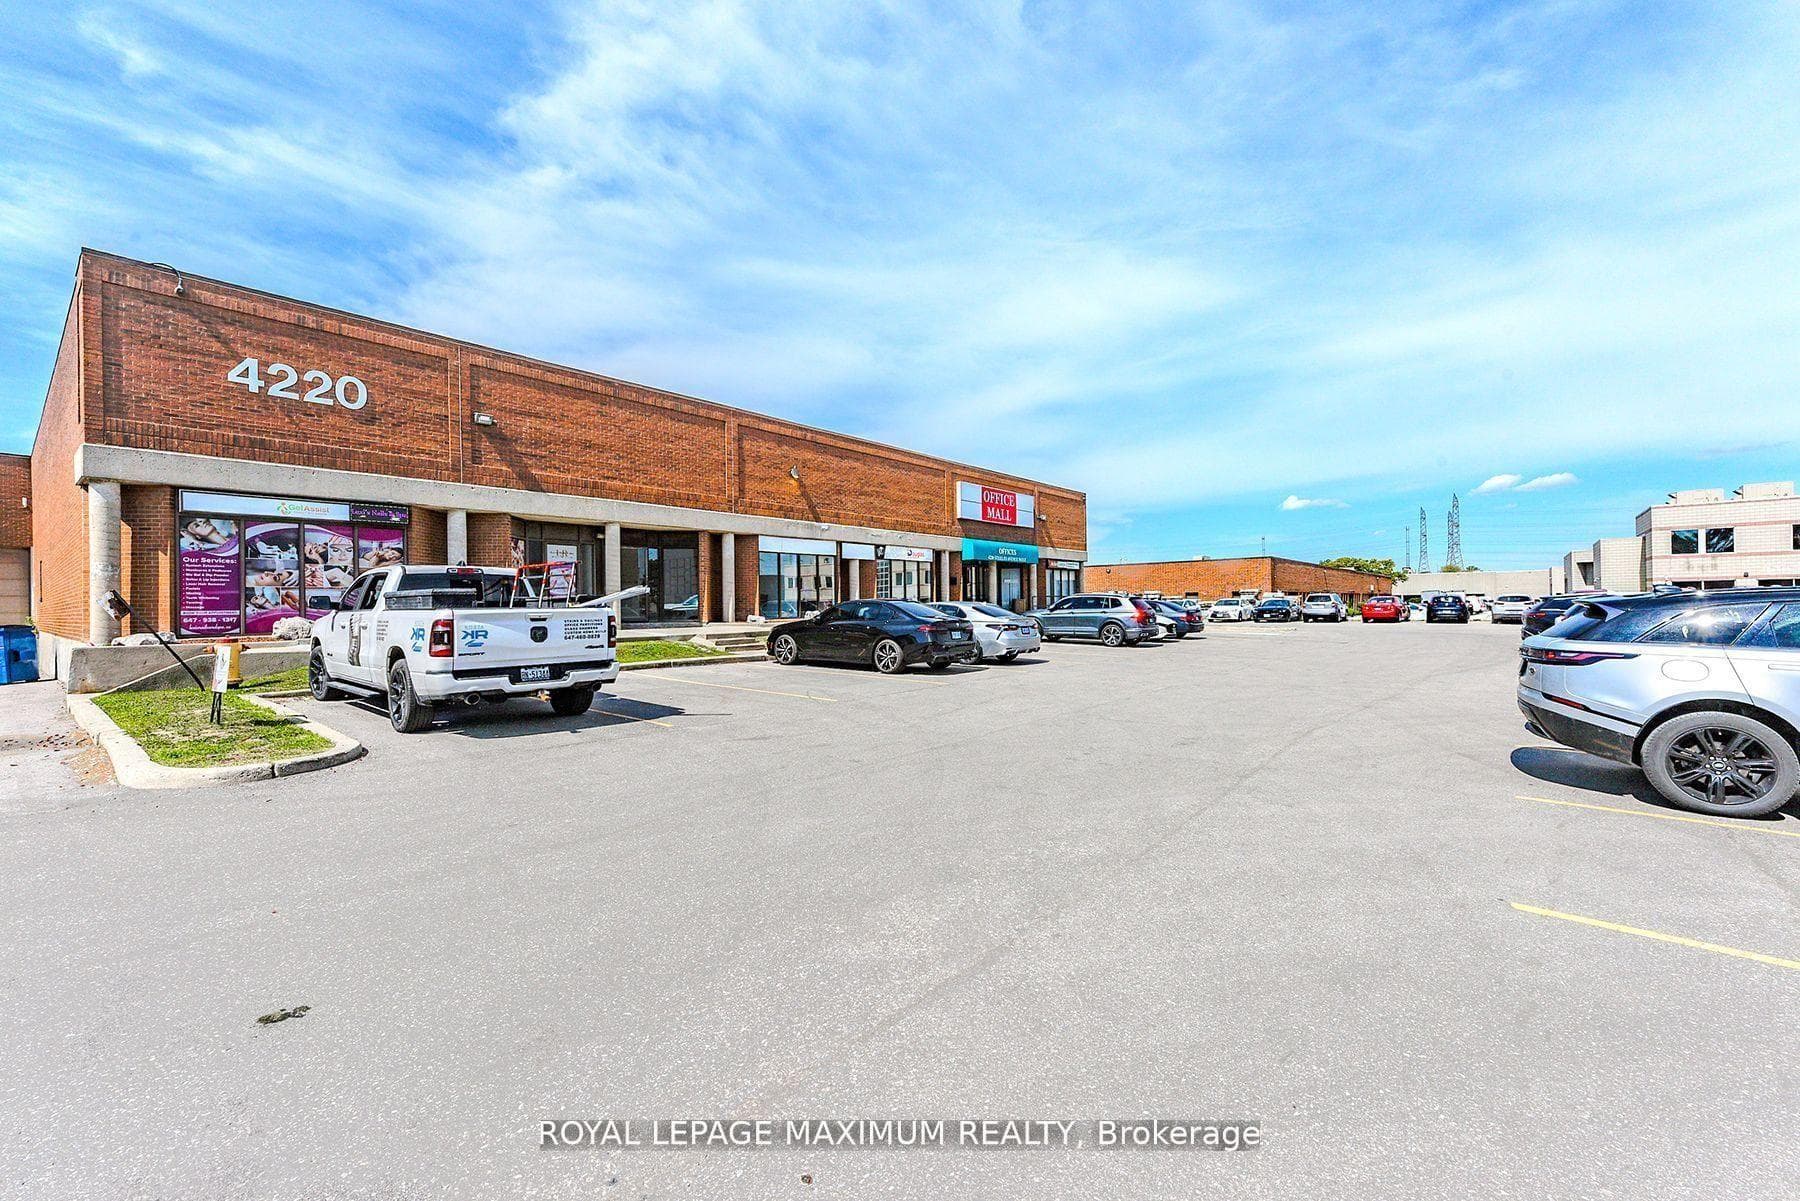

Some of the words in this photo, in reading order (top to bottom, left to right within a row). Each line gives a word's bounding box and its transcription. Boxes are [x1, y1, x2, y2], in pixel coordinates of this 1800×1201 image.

[227, 357, 368, 410] 4220
[983, 490, 1015, 507] OFFICE
[987, 506, 1012, 522] MALL
